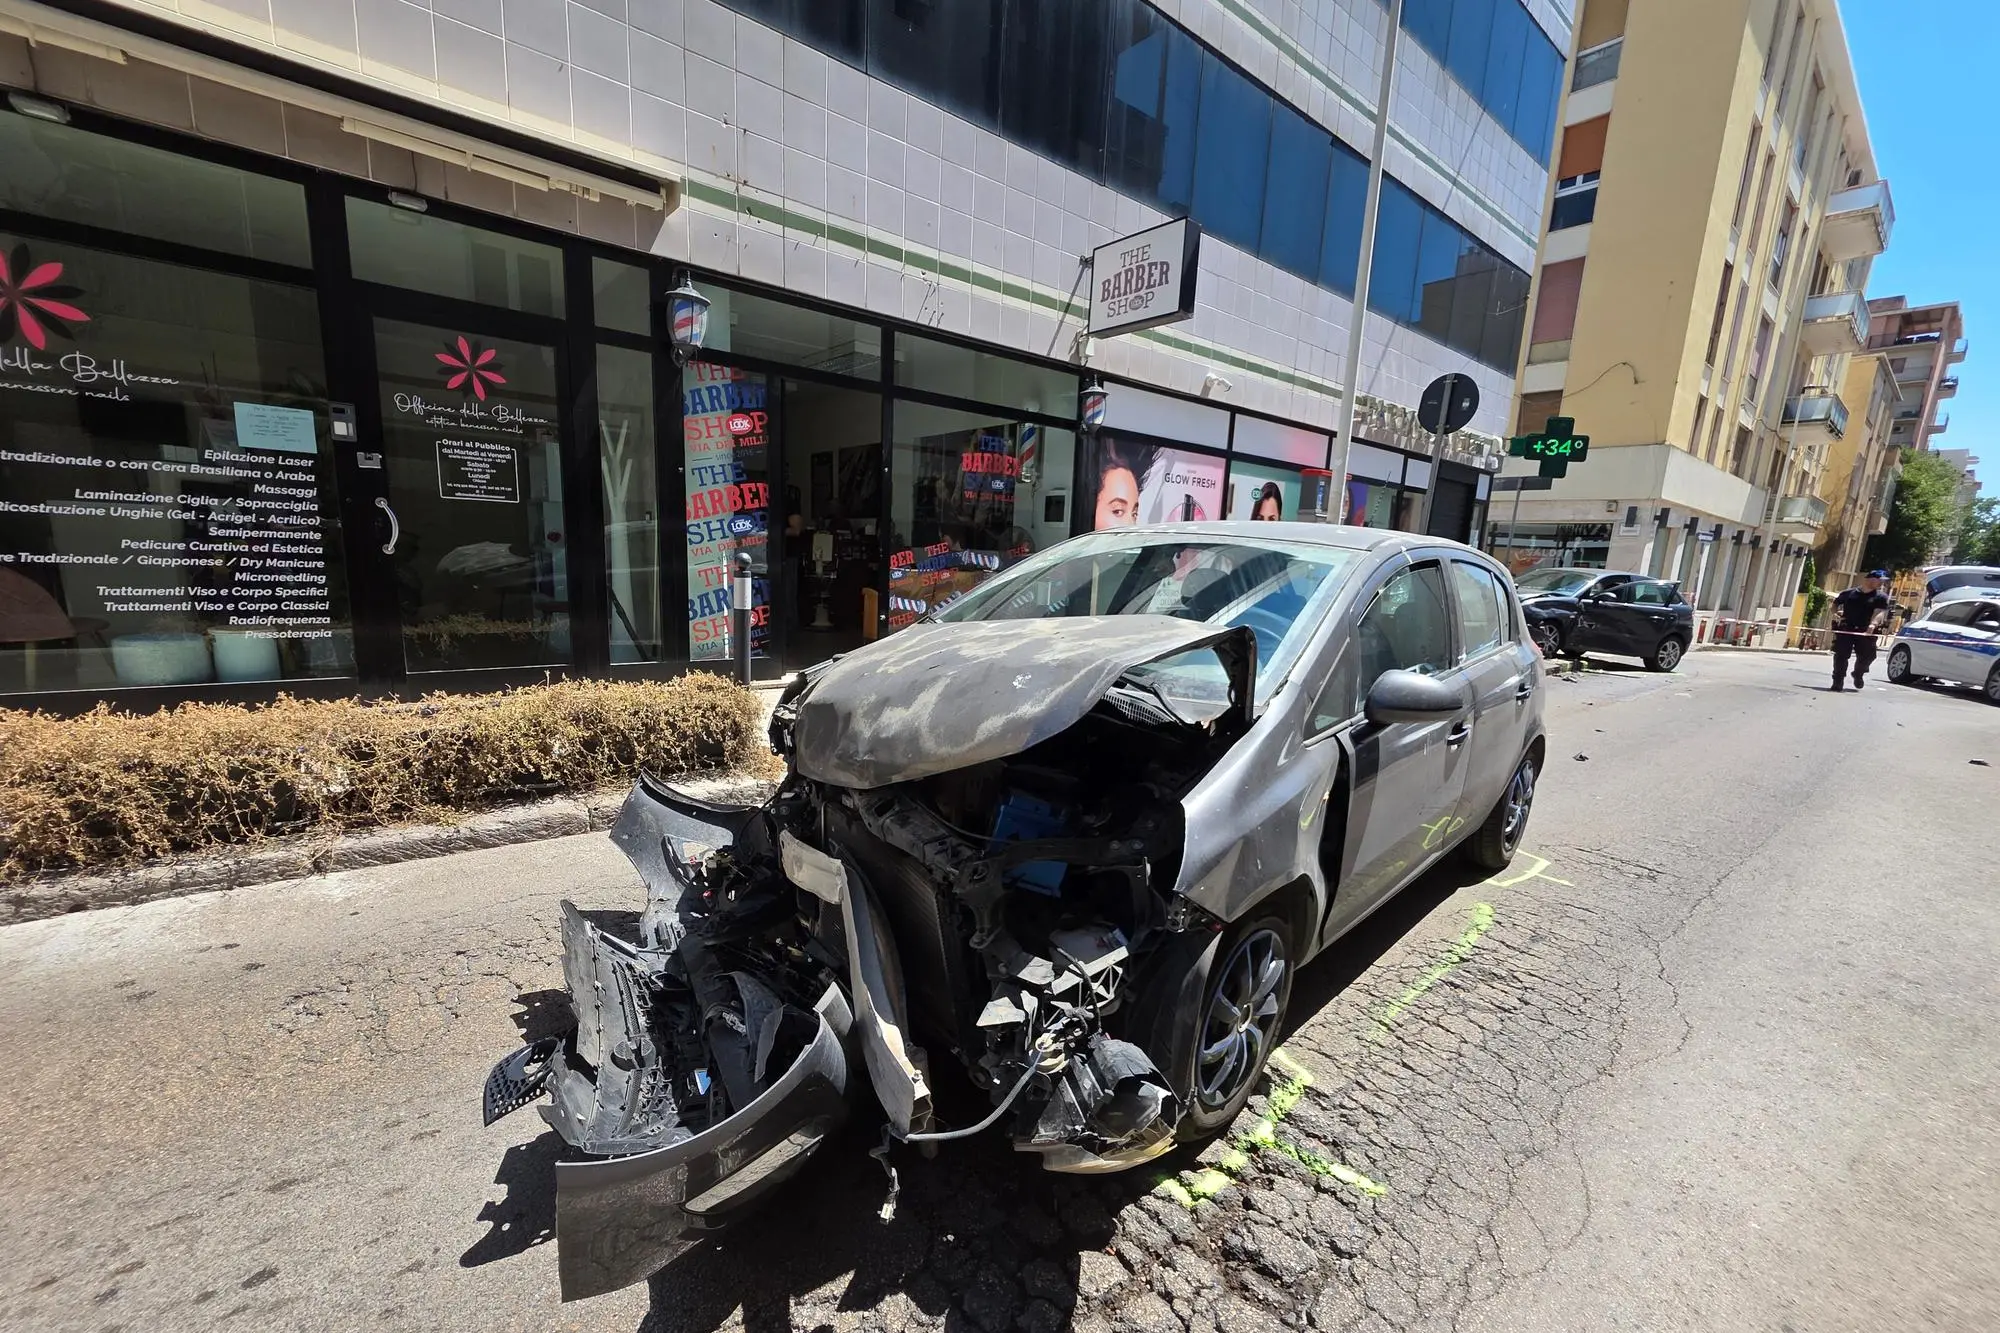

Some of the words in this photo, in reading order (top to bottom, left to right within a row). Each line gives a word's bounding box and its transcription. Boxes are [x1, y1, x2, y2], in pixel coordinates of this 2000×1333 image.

[1120, 244, 1151, 268] THE
[1100, 261, 1170, 303] BARBER
[1107, 291, 1155, 318] SHOP
[60, 350, 179, 386] Bellezza
[85, 387, 130, 402] nails
[459, 403, 488, 420] della
[491, 404, 548, 424] Bellezza
[684, 411, 768, 441] SHOP
[442, 438, 463, 447] Orari
[465, 440, 474, 448] al
[475, 441, 511, 451] Pubblico
[1533, 439, 1584, 456] +34°
[0, 450, 102, 467] tradizionale
[105, 460, 116, 468] o
[120, 460, 148, 471] con
[152, 461, 186, 473] Cera
[190, 464, 261, 478] Brasiliana
[264, 471, 273, 479] o
[275, 471, 315, 482] Araba
[204, 450, 275, 464] Epilazione
[278, 456, 314, 467] Laser
[962, 453, 1021, 476] BARBER
[692, 461, 747, 487] THE
[1164, 472, 1190, 485] GLOW
[1192, 476, 1217, 490] FRESH
[254, 484, 317, 498] Massaggi
[75, 488, 173, 503] Laminazione
[177, 494, 218, 507] Ciglia
[222, 497, 232, 506] /
[235, 498, 318, 512] Sopracciglia
[110, 507, 164, 520] Unghie
[166, 509, 195, 520] (Gel
[208, 511, 256, 525] Acrigel
[267, 516, 320, 526] Acrilico)
[208, 526, 322, 540] Semipermanente
[121, 539, 186, 550] Pedicure
[189, 541, 249, 552] Curativa
[252, 543, 269, 553] ed
[272, 544, 323, 554] Estetica
[691, 546, 712, 557] VIA
[924, 542, 950, 557] THE
[18, 552, 119, 564] Tradizionale
[122, 555, 134, 564] /
[137, 555, 223, 567] Giapponese
[226, 557, 237, 566] /
[240, 558, 263, 569] Dry
[265, 558, 325, 568] Manicure
[235, 572, 326, 584] Microneedling
[96, 585, 184, 596] Trattamenti
[188, 586, 217, 596] Viso
[220, 588, 229, 596] e
[232, 587, 272, 598] Corpo
[275, 586, 328, 597] Specifici
[104, 602, 191, 612] Trattamenti
[195, 602, 223, 611] Viso
[226, 603, 235, 611] e
[238, 602, 278, 612] Corpo
[281, 601, 329, 611] Classici
[229, 616, 331, 626] Radiofrequenza
[245, 629, 332, 640] Pressoterapia
